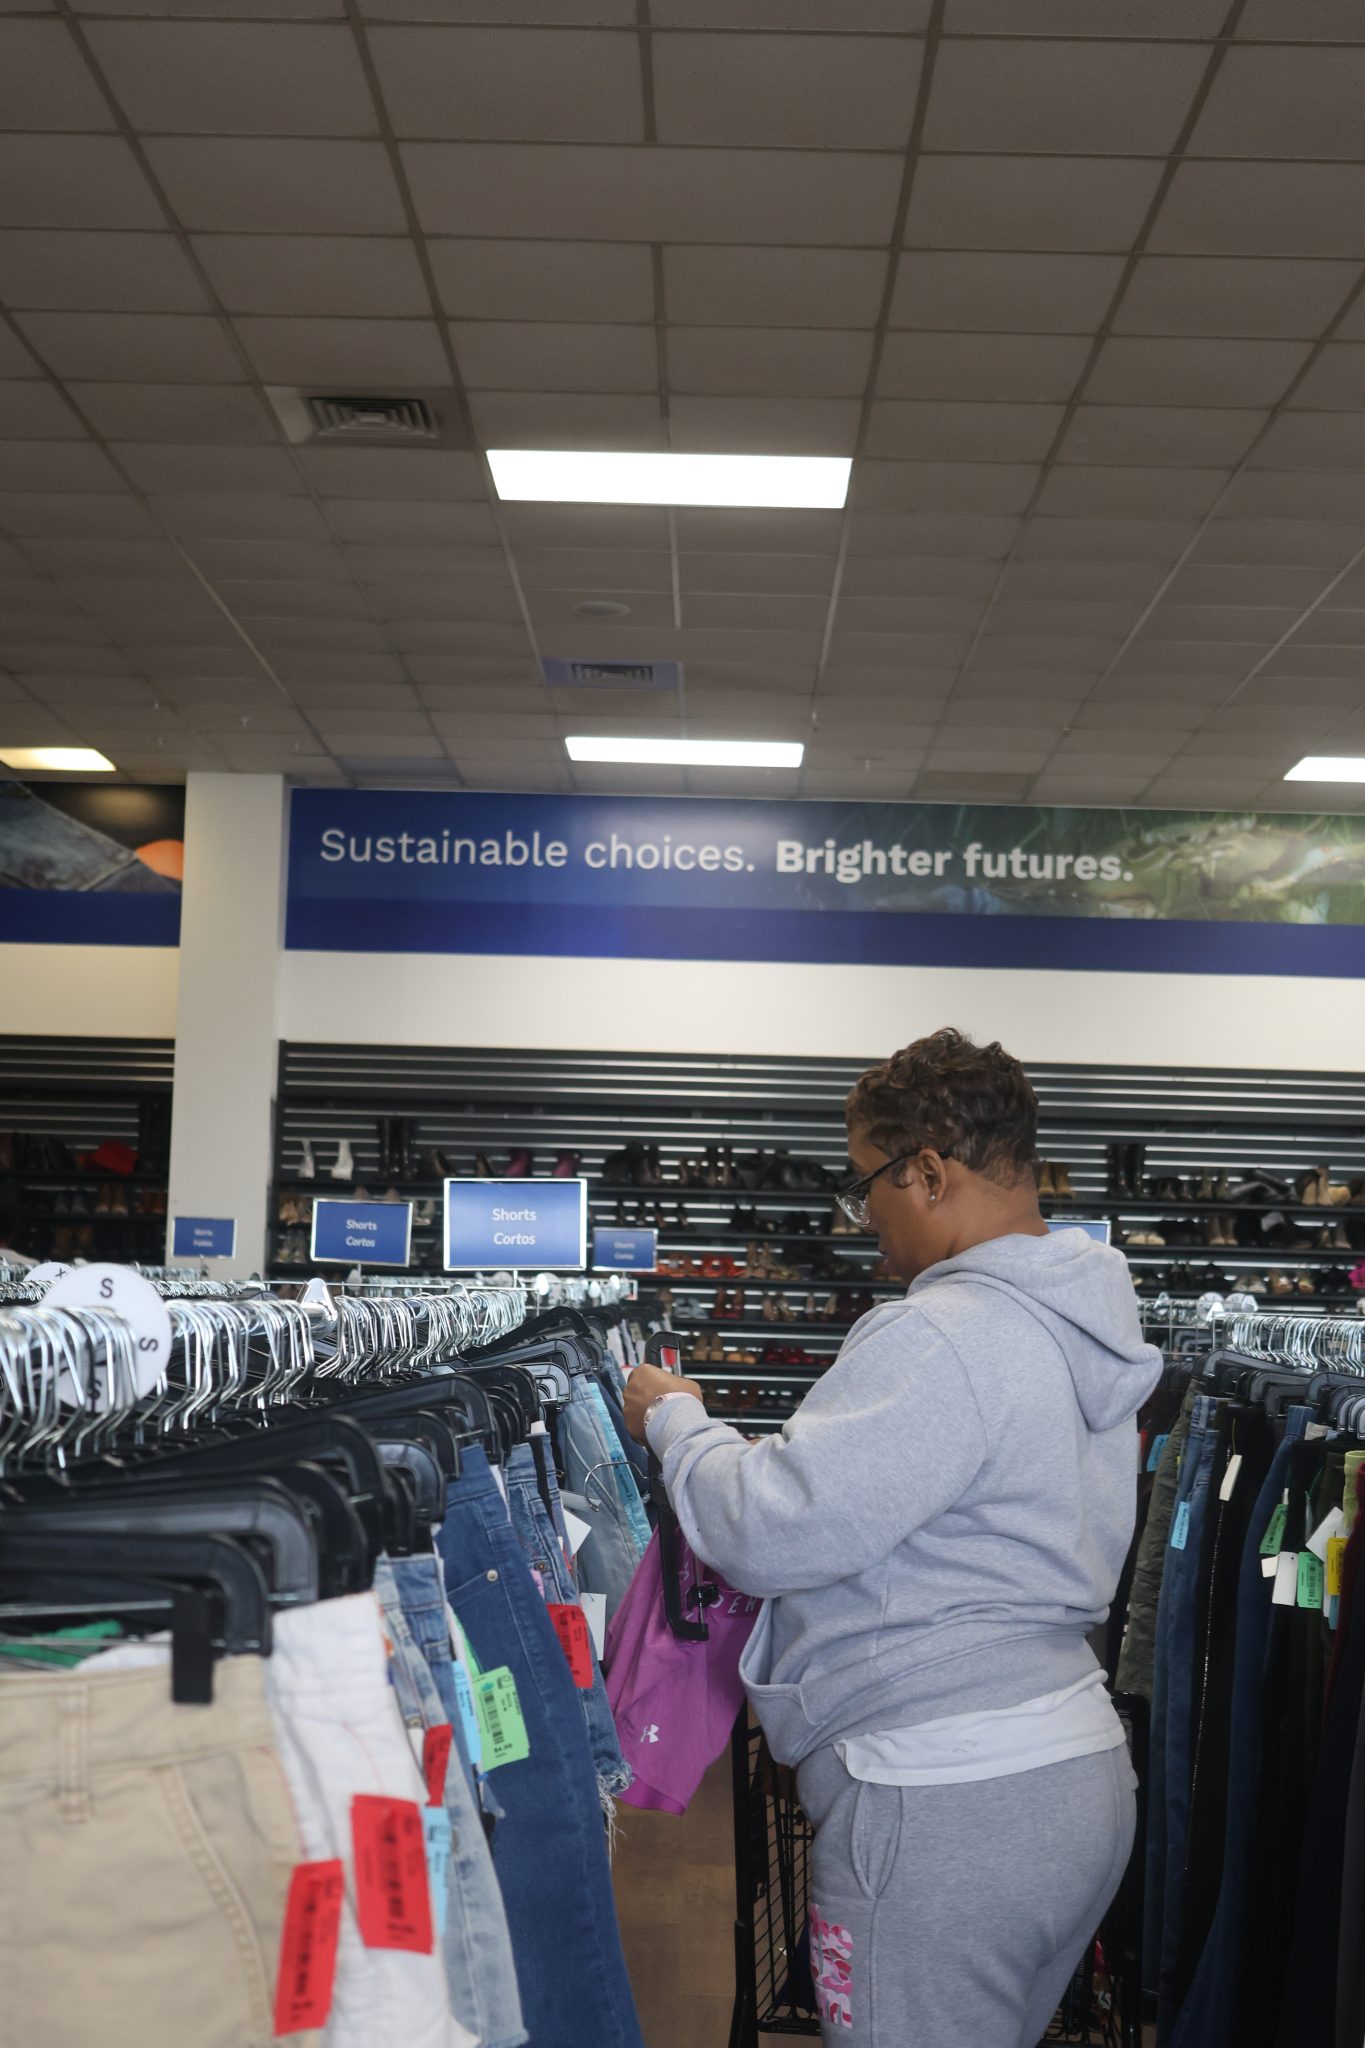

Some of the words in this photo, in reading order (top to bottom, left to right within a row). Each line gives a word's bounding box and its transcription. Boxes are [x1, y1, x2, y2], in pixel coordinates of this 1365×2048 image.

[320, 828, 569, 868] Sustainable
[584, 833, 756, 873] choices.
[775, 837, 952, 884] Brighter
[962, 842, 1135, 882] futures.
[491, 1208, 537, 1221] Shorts
[345, 1218, 377, 1231] Shorts
[345, 1235, 376, 1248] Cortos
[493, 1232, 536, 1245] Cortos
[100, 1278, 114, 1298] S
[139, 1337, 158, 1352] S
